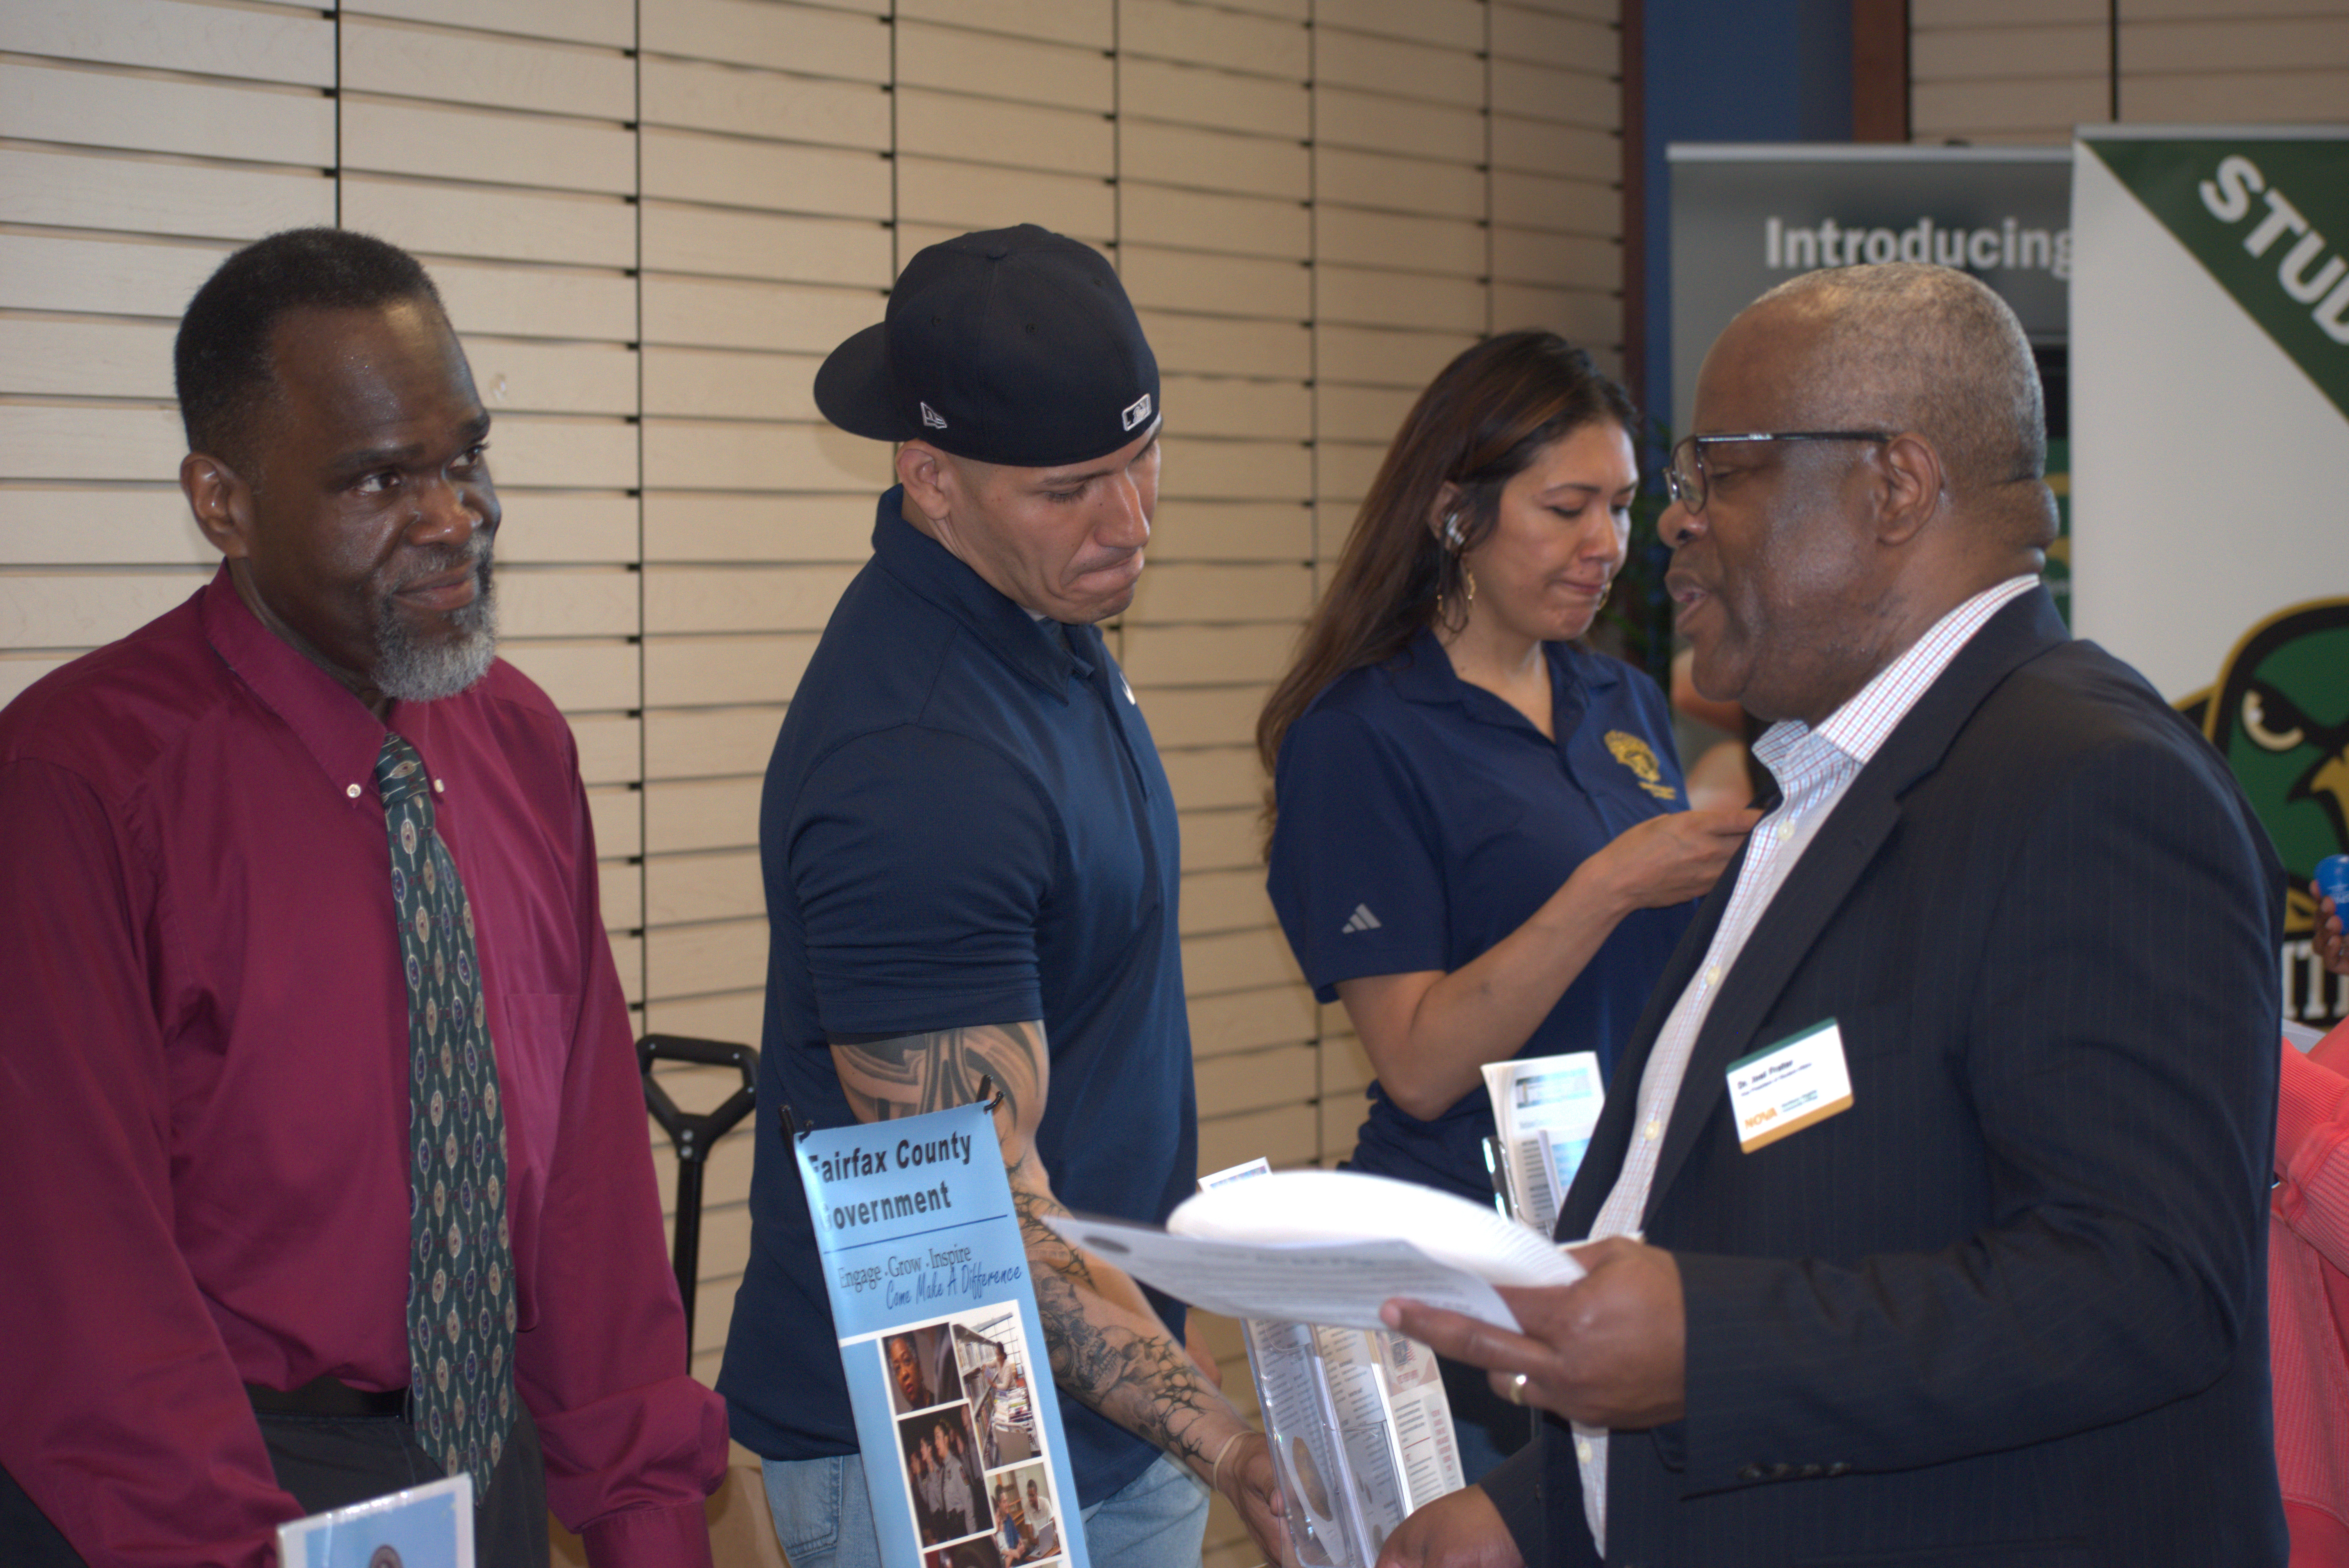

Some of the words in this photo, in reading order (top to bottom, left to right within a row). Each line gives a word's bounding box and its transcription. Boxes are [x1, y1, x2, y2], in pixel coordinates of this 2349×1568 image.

[1765, 216, 2072, 280] Introducing
[1744, 1107, 1778, 1130] NOVA
[896, 1131, 971, 1169] County
[837, 1265, 882, 1293] Engage
[886, 1279, 912, 1310] Come
[915, 1271, 944, 1304] Make
[947, 1267, 957, 1296] A
[961, 1262, 1022, 1300] Difference
